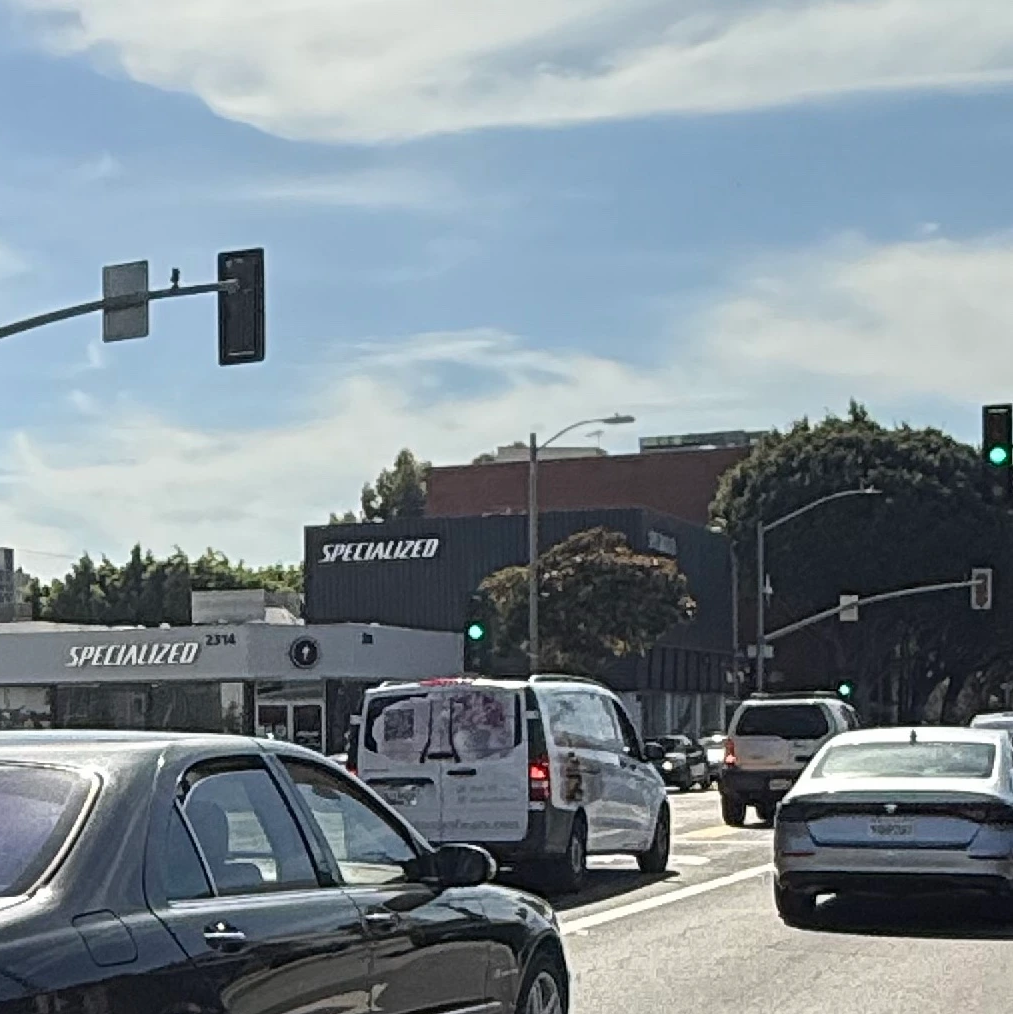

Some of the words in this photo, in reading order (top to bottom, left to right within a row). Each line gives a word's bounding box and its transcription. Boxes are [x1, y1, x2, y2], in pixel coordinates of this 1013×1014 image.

[319, 538, 439, 563] SPECIALIZED
[65, 642, 199, 667] SPECIALIZED
[205, 634, 236, 646] 2314
